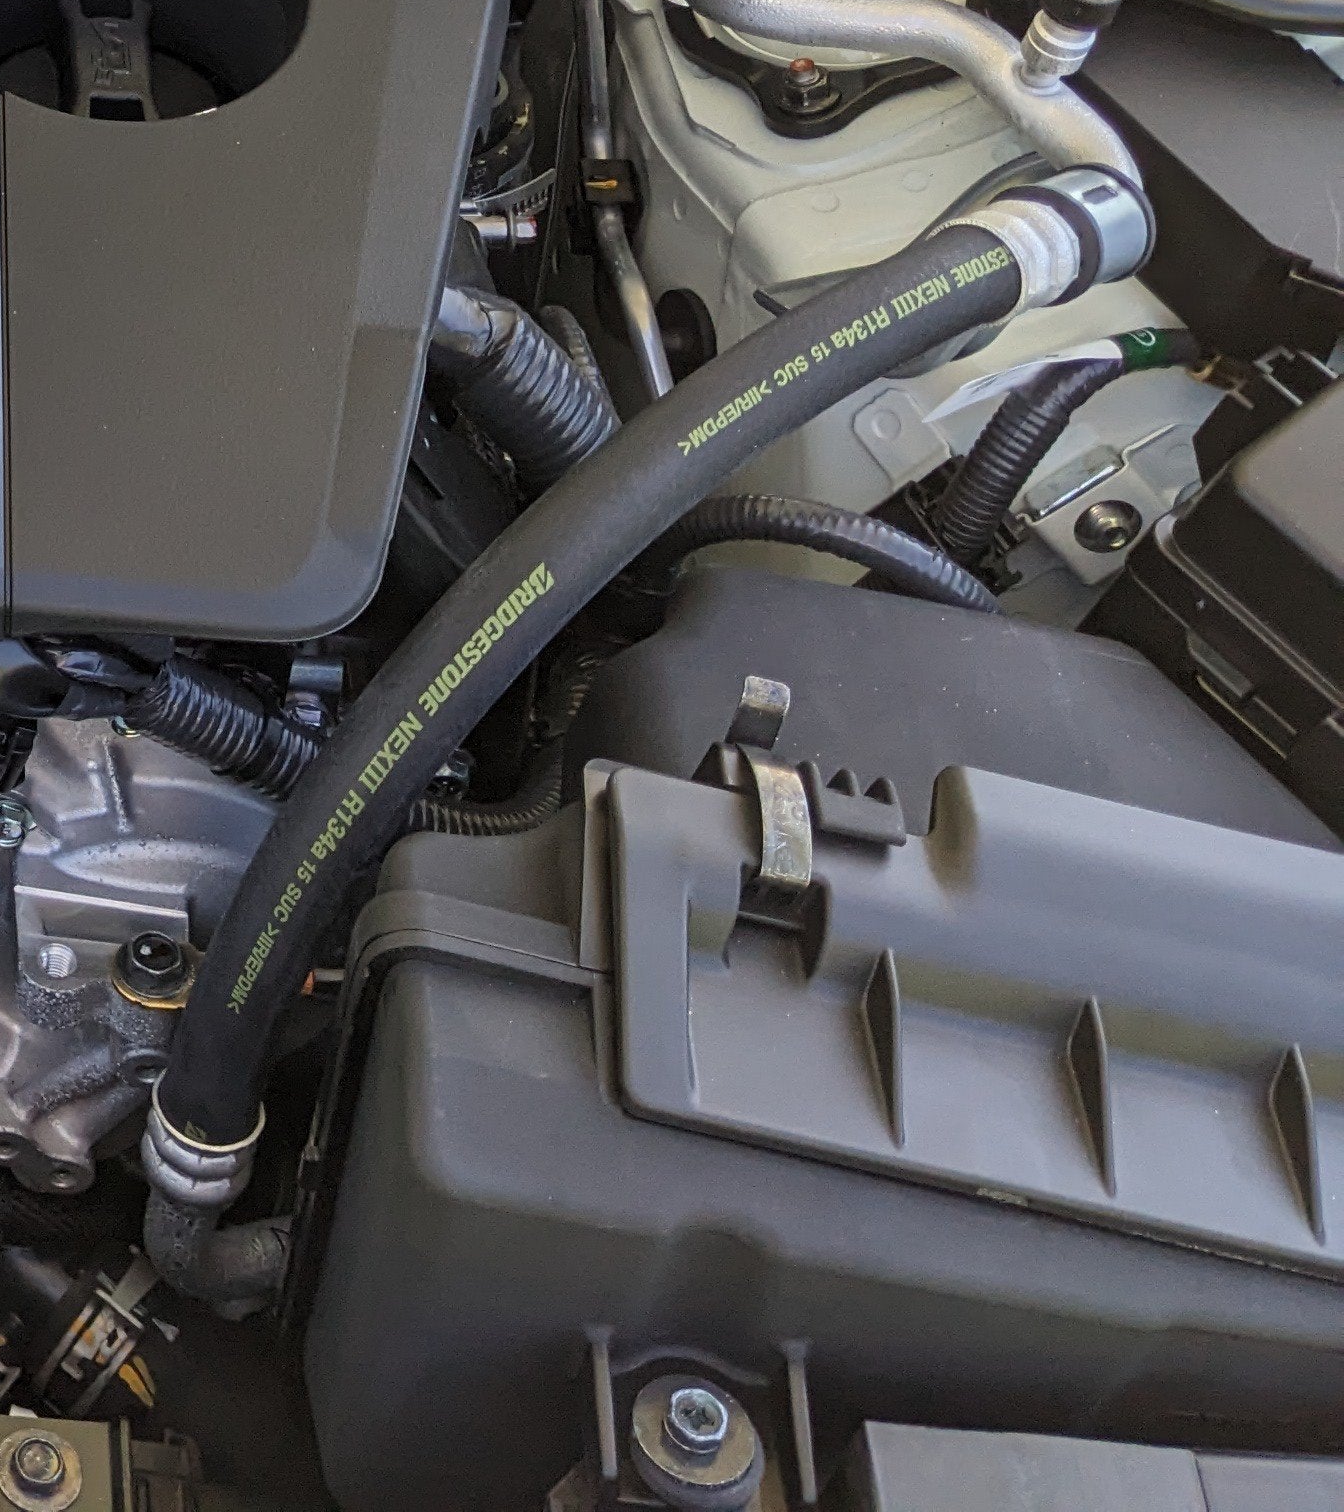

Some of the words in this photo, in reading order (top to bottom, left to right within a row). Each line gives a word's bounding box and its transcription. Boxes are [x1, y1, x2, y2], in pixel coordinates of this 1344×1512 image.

[829, 306, 891, 349] R134a
[774, 355, 809, 387] SUC
[810, 341, 831, 363] 15
[418, 562, 554, 717] BRIDGESTONE
[311, 788, 365, 860] R134a
[296, 860, 317, 884] 15
[273, 883, 303, 923] SUC
